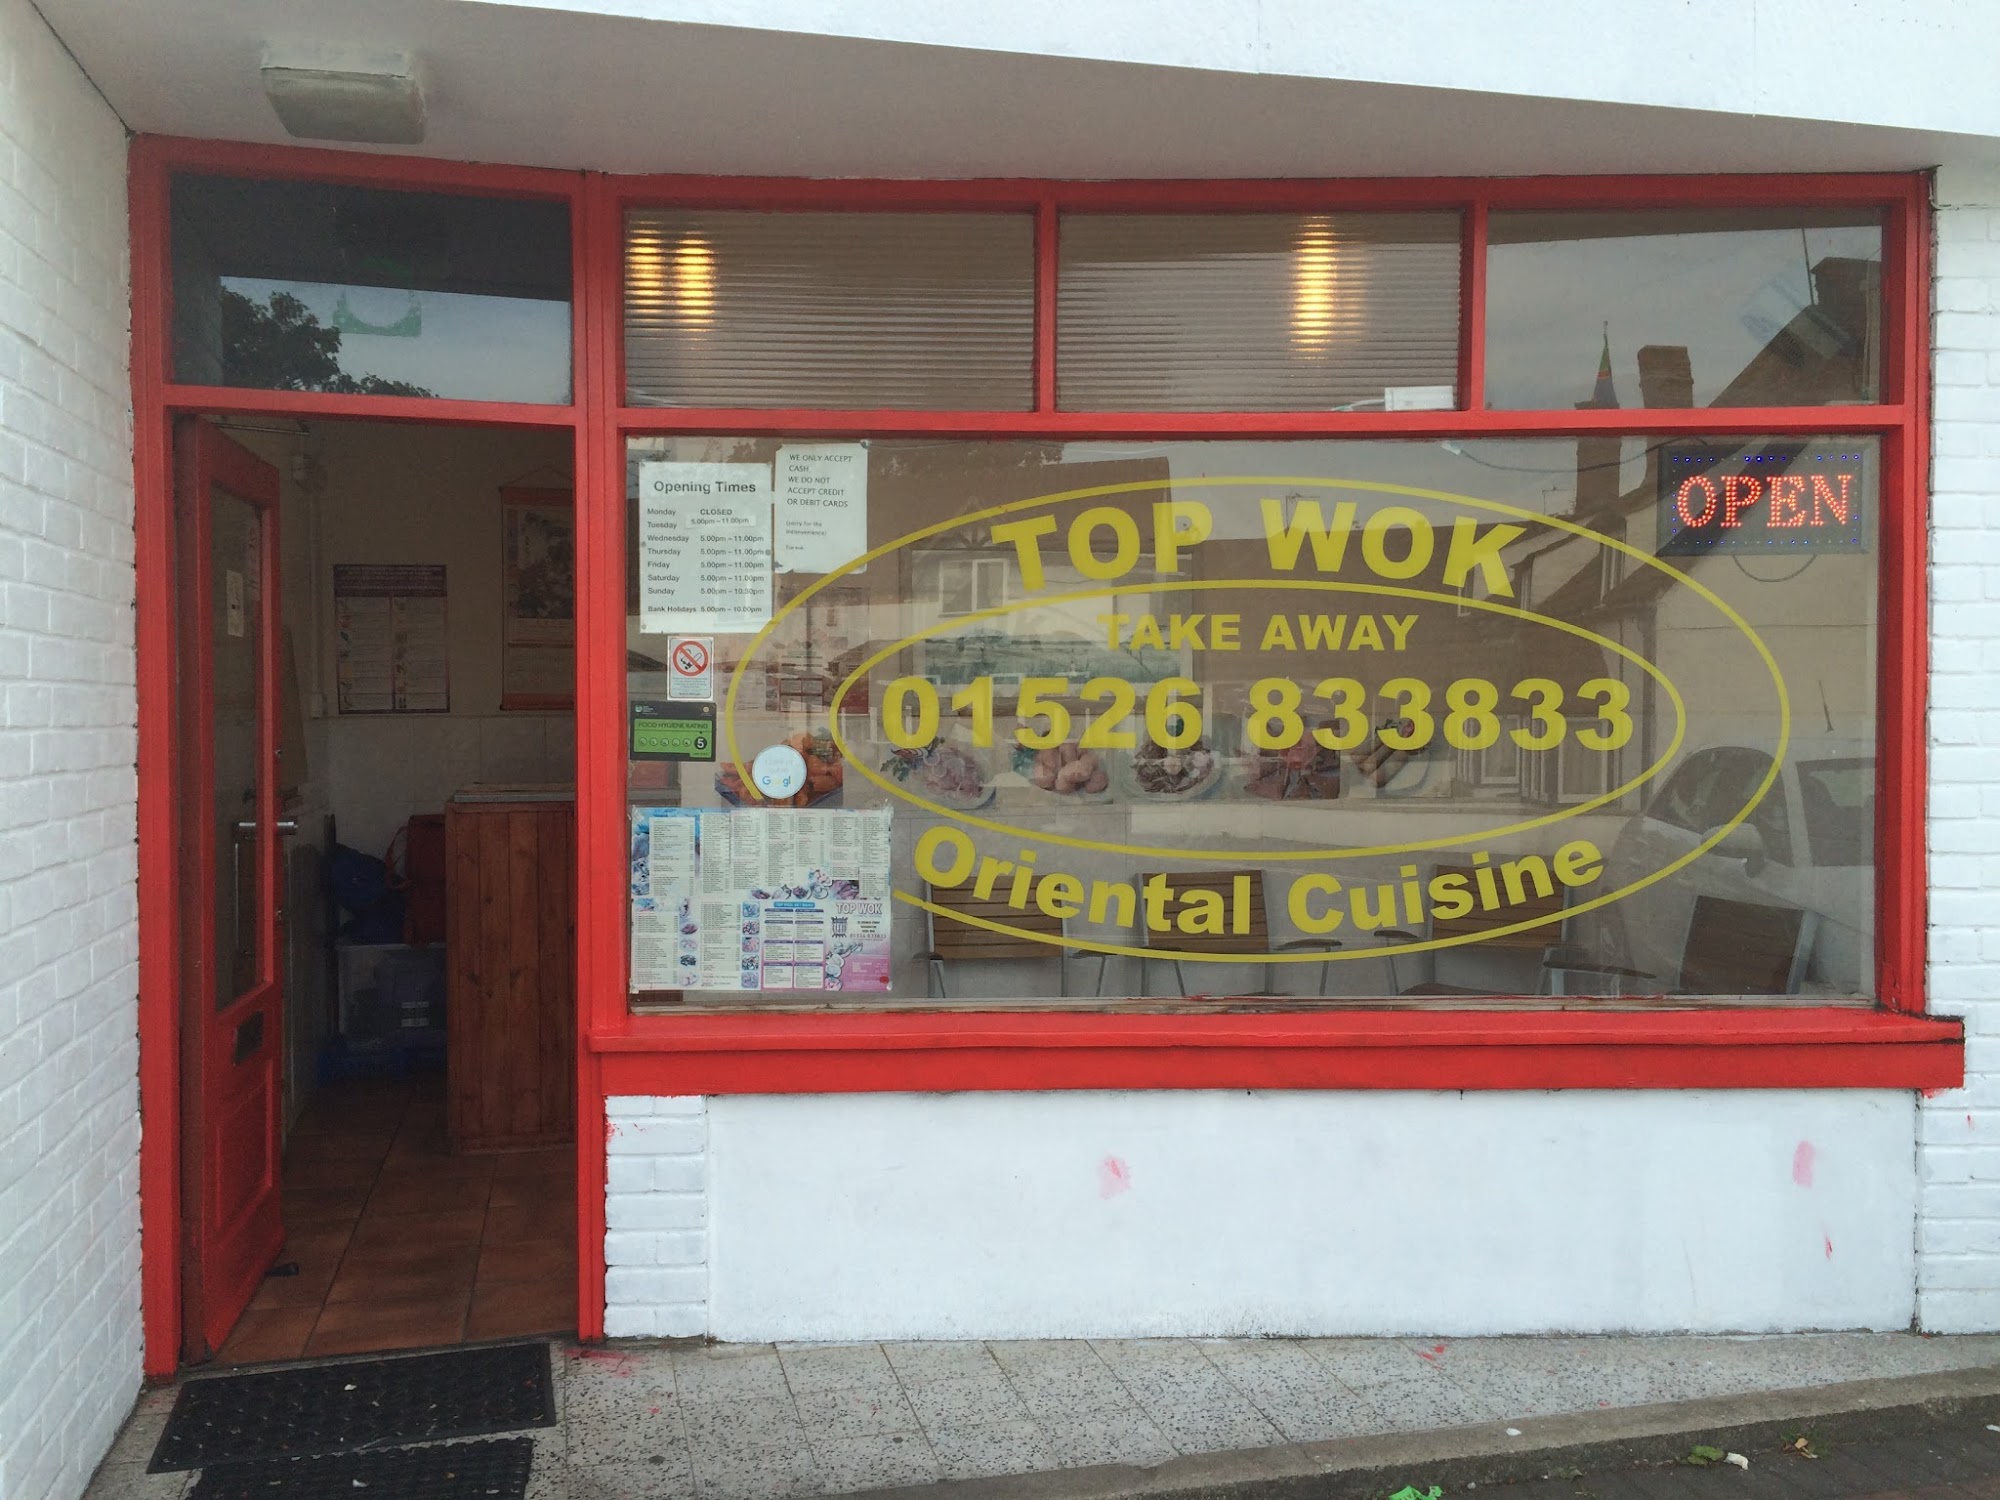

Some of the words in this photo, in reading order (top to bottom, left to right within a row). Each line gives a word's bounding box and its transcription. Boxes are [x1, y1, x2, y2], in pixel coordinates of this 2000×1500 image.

[654, 480, 710, 494] Opening
[715, 481, 756, 492] Times
[818, 488, 844, 496] CREDIT
[822, 499, 848, 508] CARDS
[1677, 474, 1852, 528] OPEN
[647, 508, 676, 516] Monday
[648, 521, 677, 529] Tuesday
[647, 534, 690, 543] Wednesday
[648, 547, 681, 556] Thursday
[990, 501, 1213, 592] TOP
[1260, 499, 1526, 598] WOK
[648, 560, 670, 569] Friday
[648, 574, 680, 583] Saturday
[648, 587, 675, 596] Sunday
[667, 606, 696, 614] Holidays
[1096, 613, 1242, 651] TAKE
[1260, 613, 1419, 651] AWAY
[882, 676, 1204, 751] 01526
[1247, 677, 1634, 753] 833833
[696, 738, 705, 748] 5
[914, 826, 1252, 936] Oriental
[1288, 840, 1604, 935] Cuisine
[836, 903, 857, 914] TOP
[857, 903, 883, 915] WOK
